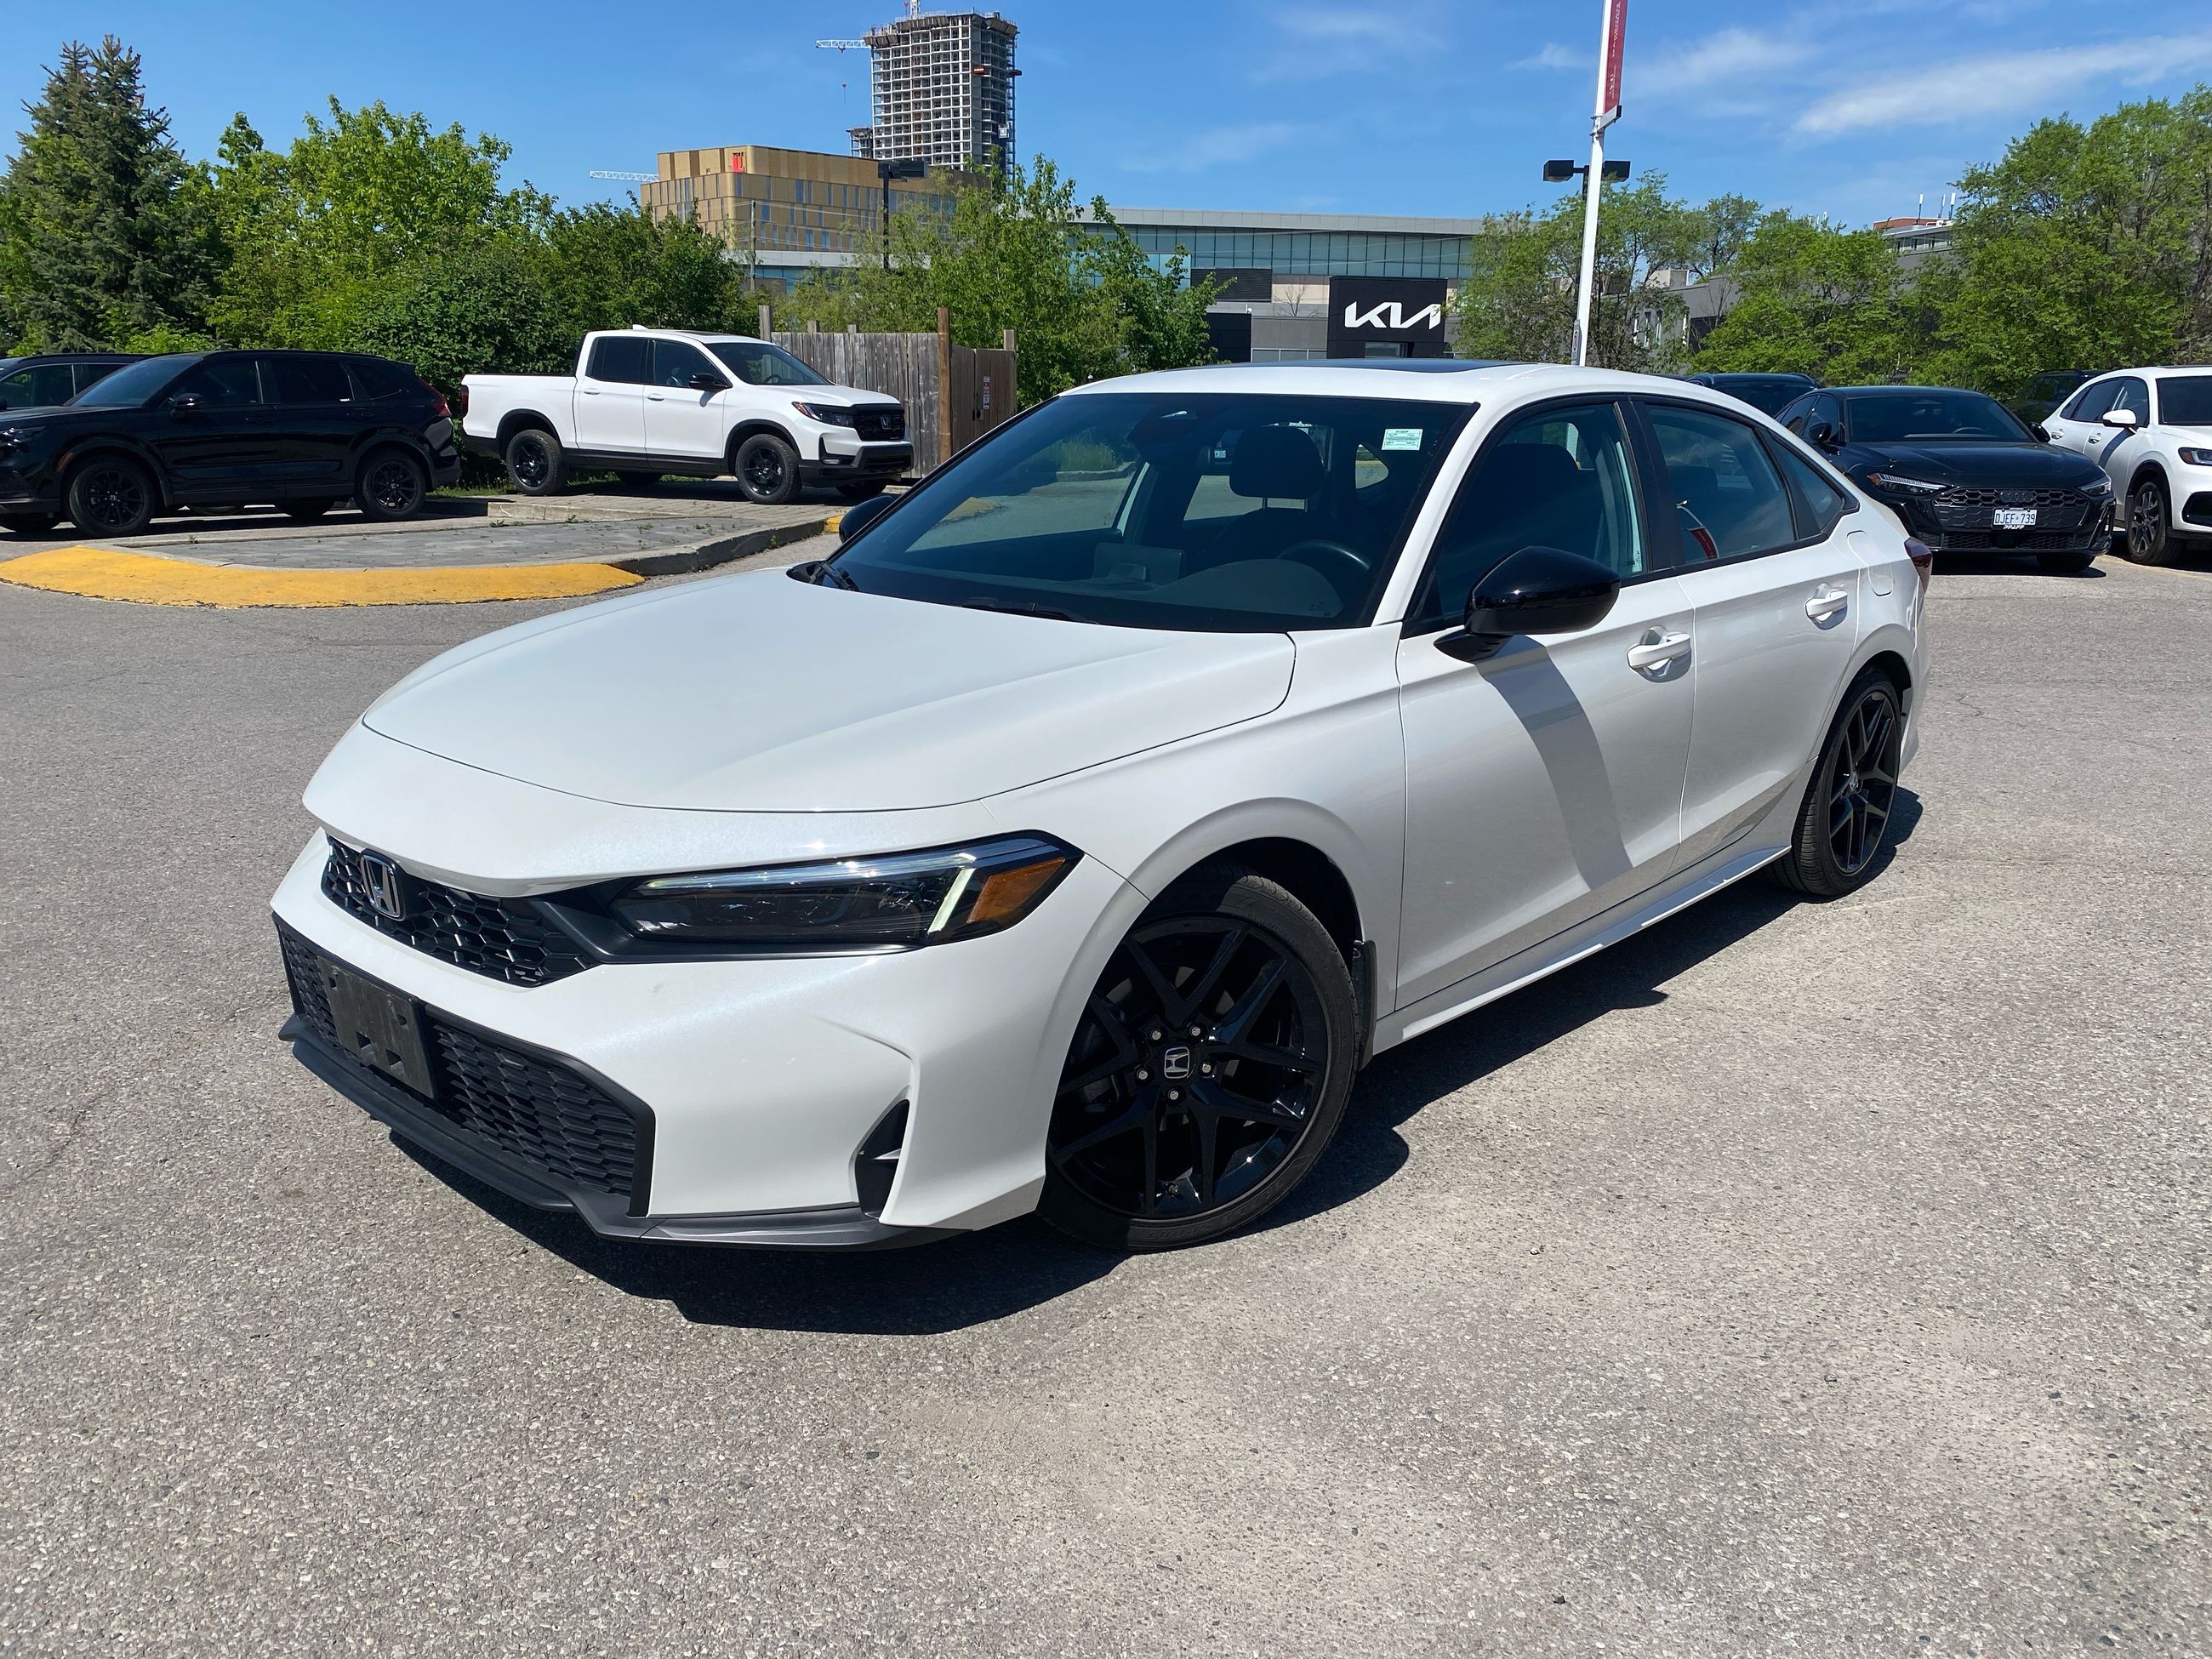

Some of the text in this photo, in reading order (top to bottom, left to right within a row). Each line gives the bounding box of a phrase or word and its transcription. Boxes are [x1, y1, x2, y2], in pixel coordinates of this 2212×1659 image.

[1344, 301, 1441, 330] KIA
[1995, 513, 2035, 524] DJEF 739
